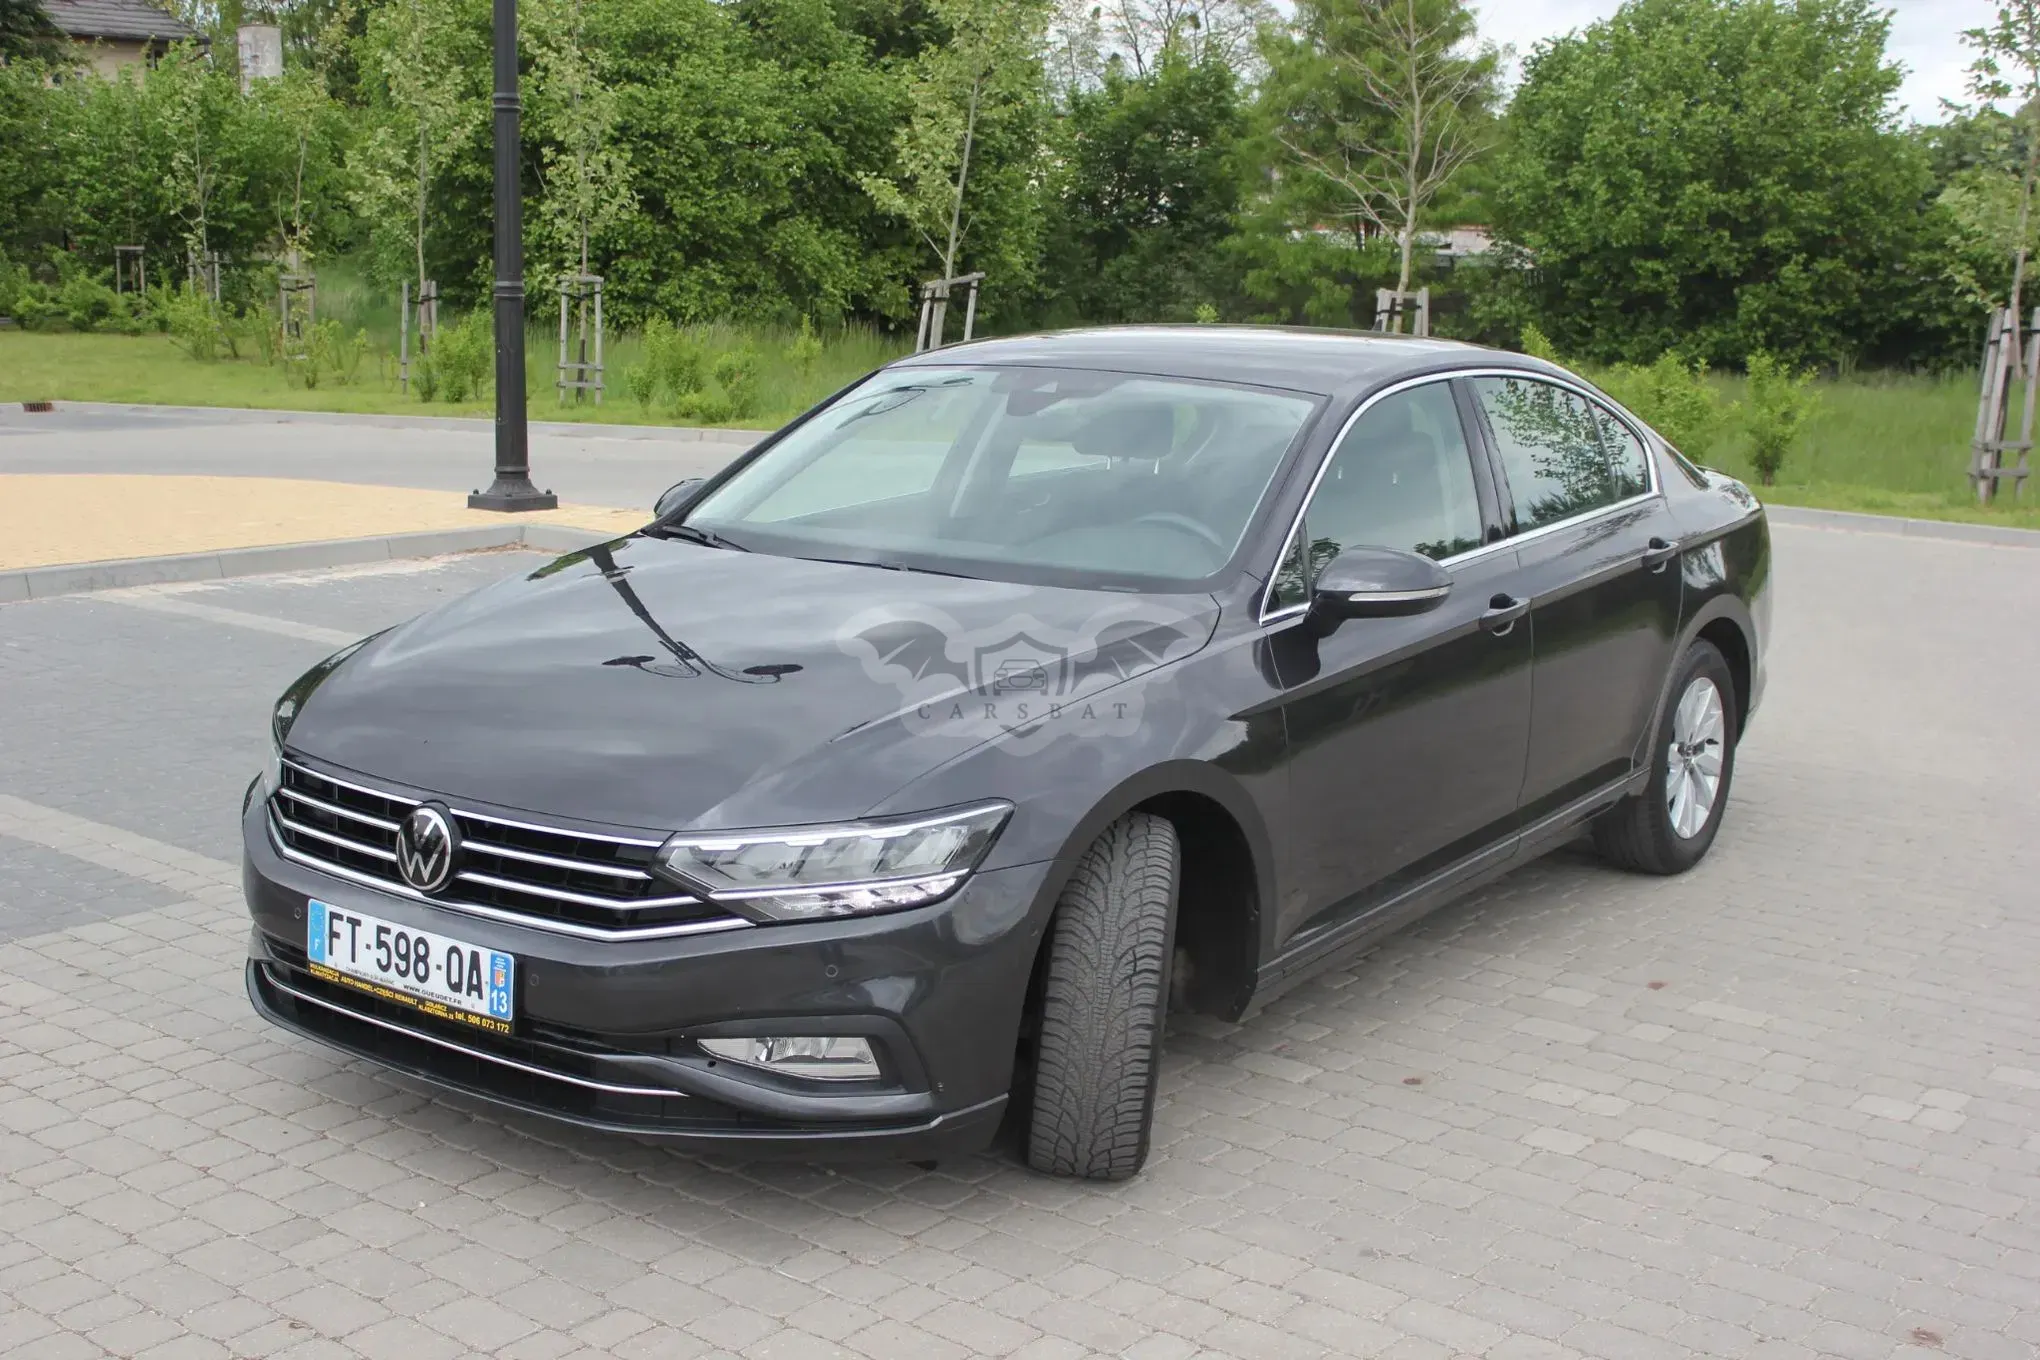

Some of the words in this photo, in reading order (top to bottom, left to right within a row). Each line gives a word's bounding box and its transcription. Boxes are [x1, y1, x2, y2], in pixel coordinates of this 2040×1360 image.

[313, 937, 320, 950] F
[328, 911, 484, 1000] FT-598-QA
[491, 989, 508, 1013] 13
[455, 1011, 467, 1021] tel.
[467, 1014, 481, 1025] 506
[481, 1018, 495, 1029] 073
[496, 1022, 510, 1034] 172
